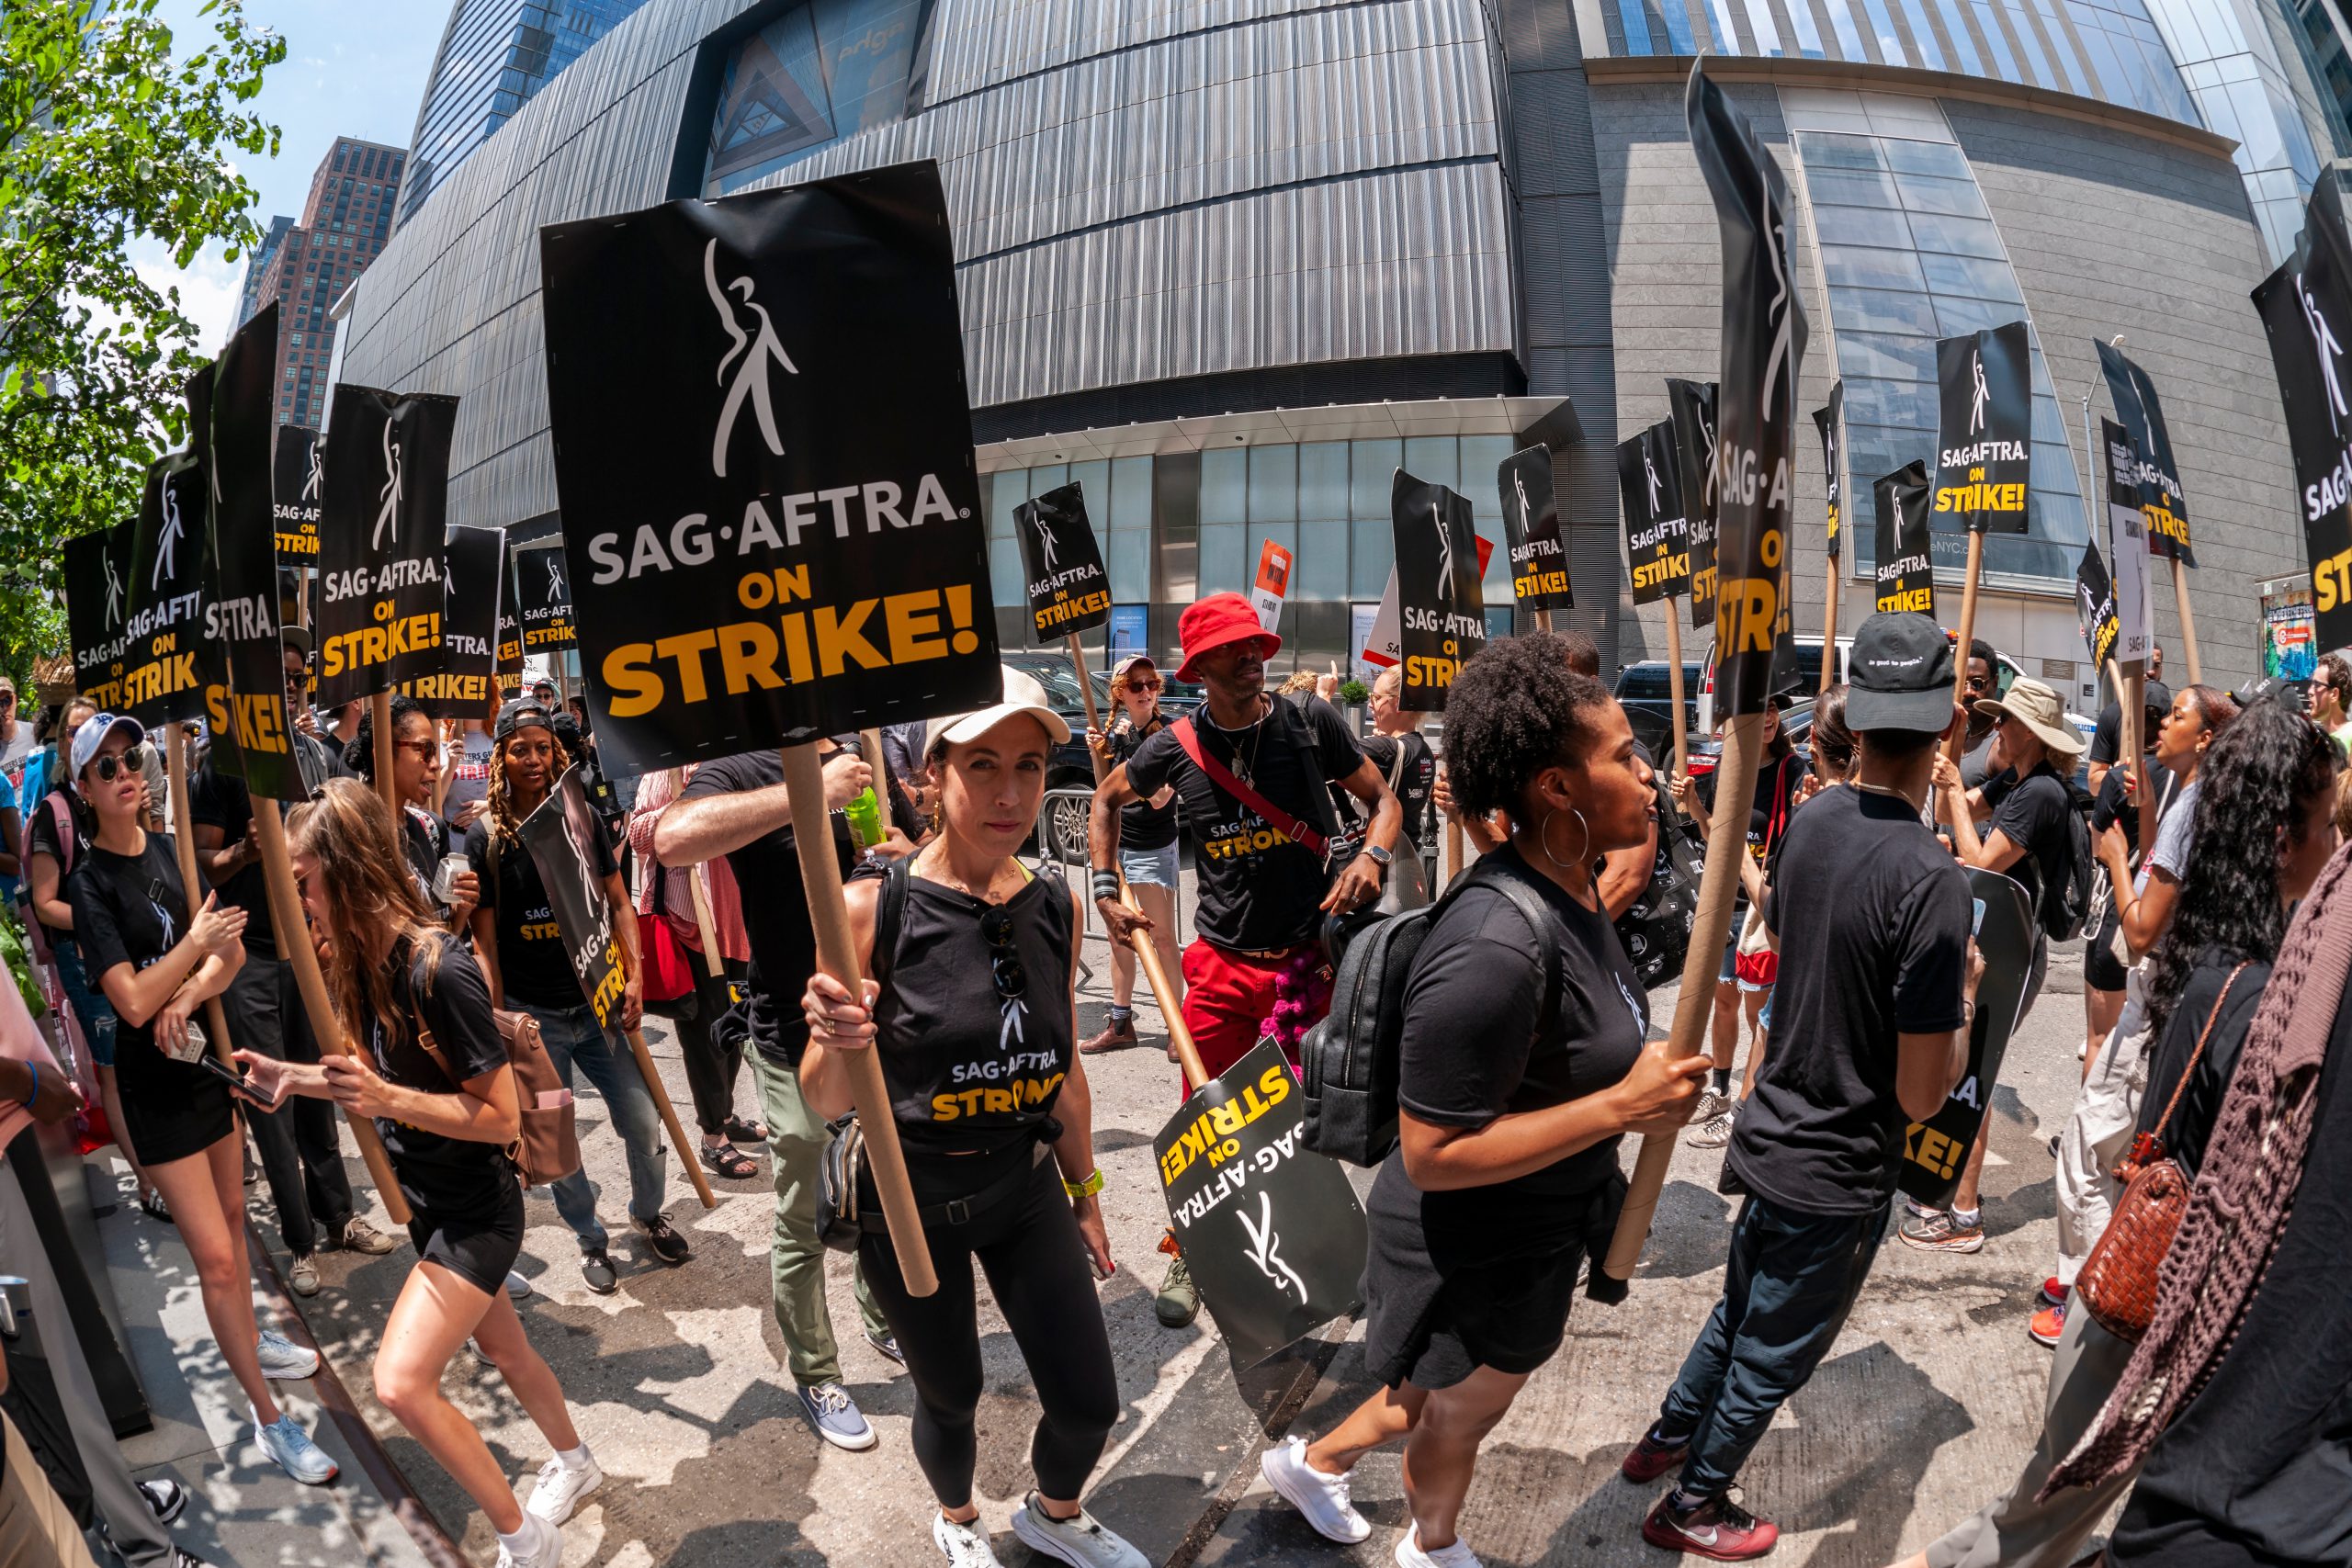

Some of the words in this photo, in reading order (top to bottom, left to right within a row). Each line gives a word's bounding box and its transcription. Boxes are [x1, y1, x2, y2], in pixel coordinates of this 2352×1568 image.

[1969, 467, 1984, 481] ON
[1934, 483, 2025, 513] STRIKE!
[300, 524, 316, 534] ON
[1657, 543, 1668, 558] ON
[738, 564, 811, 609] ON
[1055, 590, 1068, 603] ON
[373, 599, 395, 621] ON
[550, 618, 565, 626] ON
[1035, 590, 1110, 629] STRIKE!
[153, 633, 175, 657] ON
[323, 612, 441, 677] STRIKE!
[602, 584, 979, 718] STRIKE!
[1205, 827, 1292, 860] STRON
[932, 1073, 1065, 1122] STRON
[1160, 1065, 1291, 1187] STRIKE!
[1206, 1138, 1240, 1168] ON
